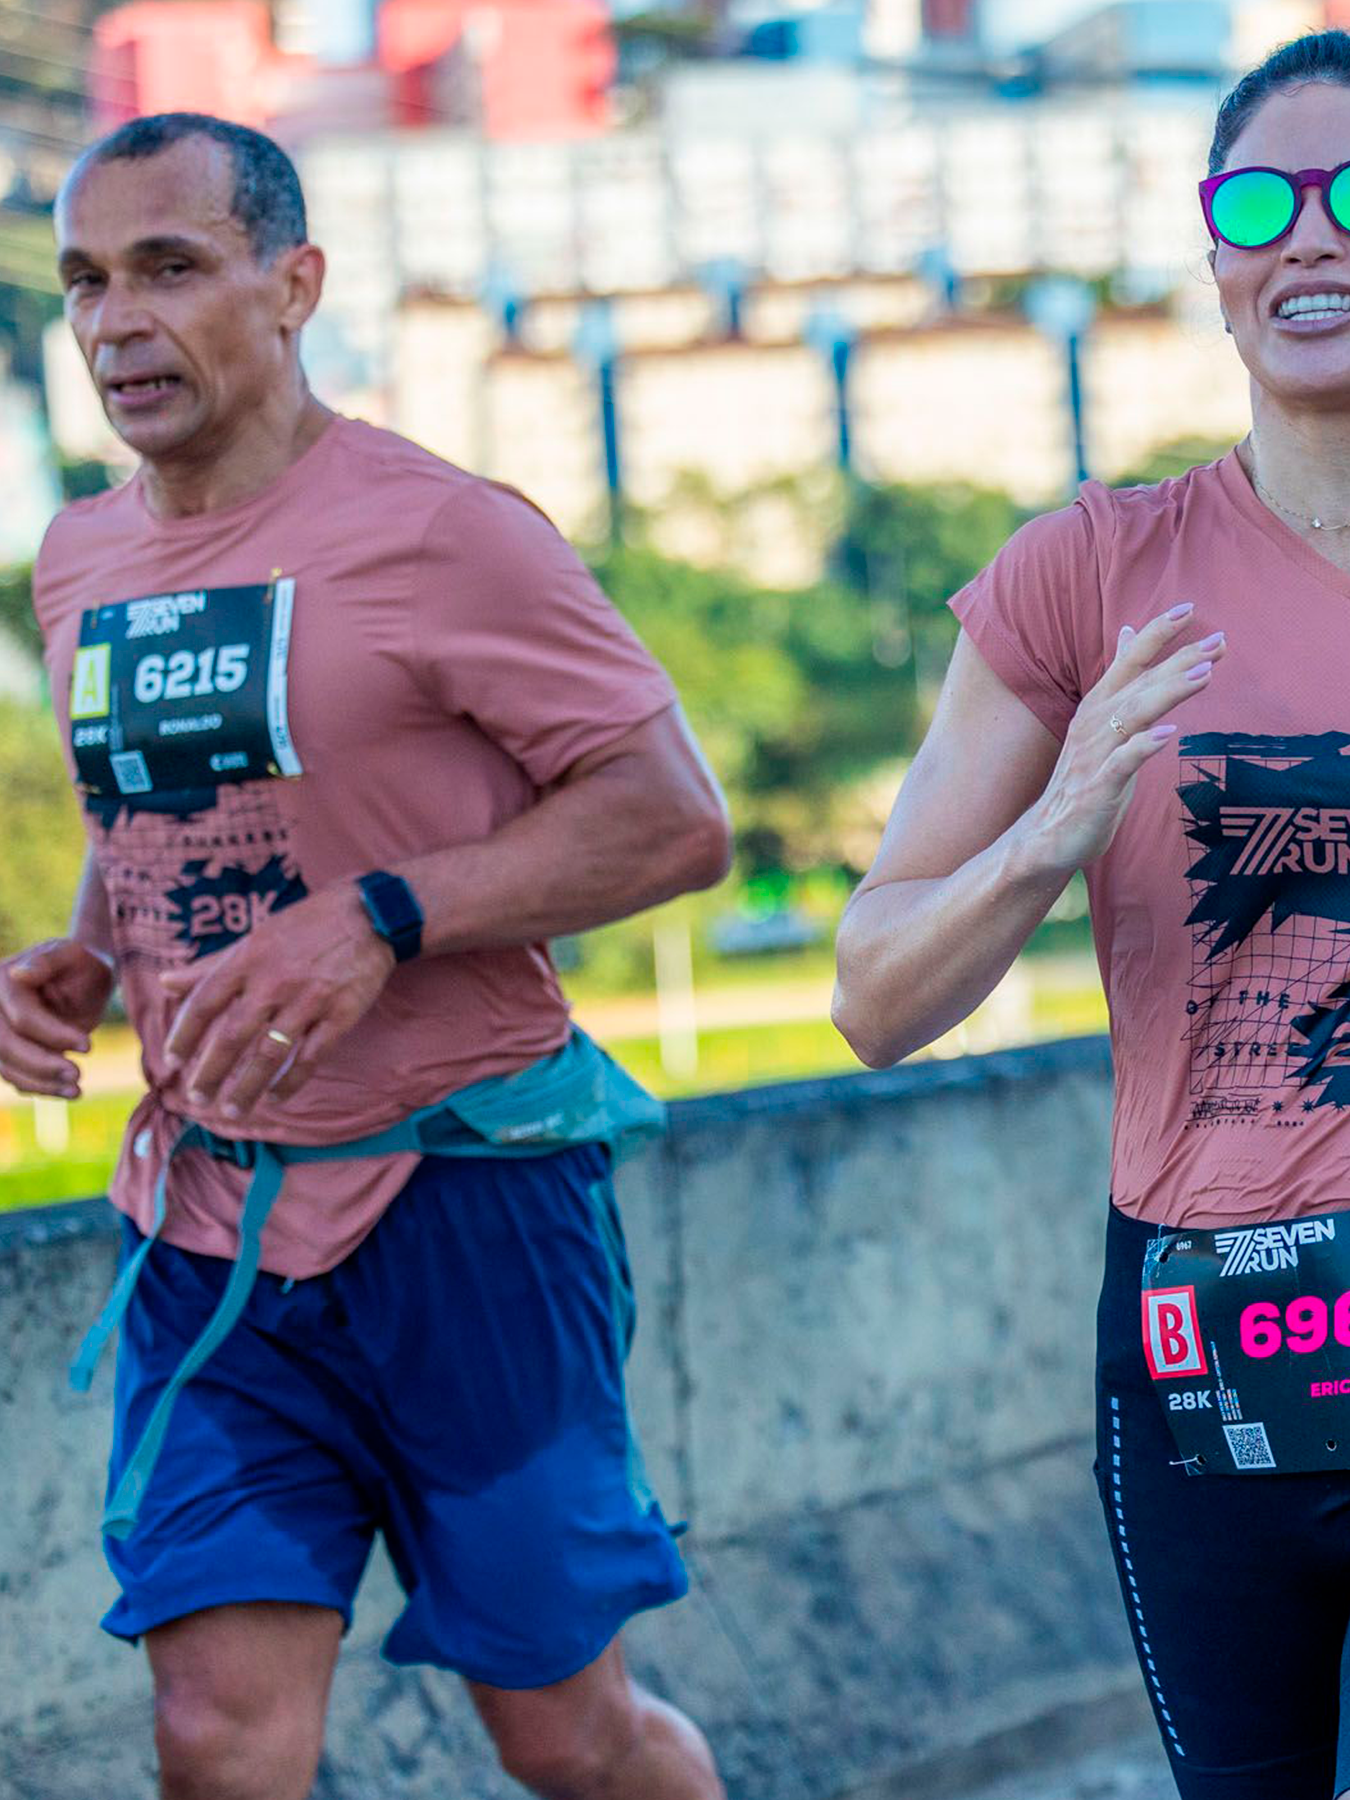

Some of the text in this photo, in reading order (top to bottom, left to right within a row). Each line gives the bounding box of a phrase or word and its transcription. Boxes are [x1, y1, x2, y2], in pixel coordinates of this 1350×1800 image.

[81, 659, 100, 705] A
[134, 643, 250, 703] 6215
[190, 889, 278, 934] 28K
[1239, 988, 1290, 1010] THE
[1253, 1218, 1336, 1250] SEVEN
[1244, 1245, 1299, 1275] RUN
[1156, 1301, 1190, 1366] B
[1168, 1389, 1213, 1411] 28K
